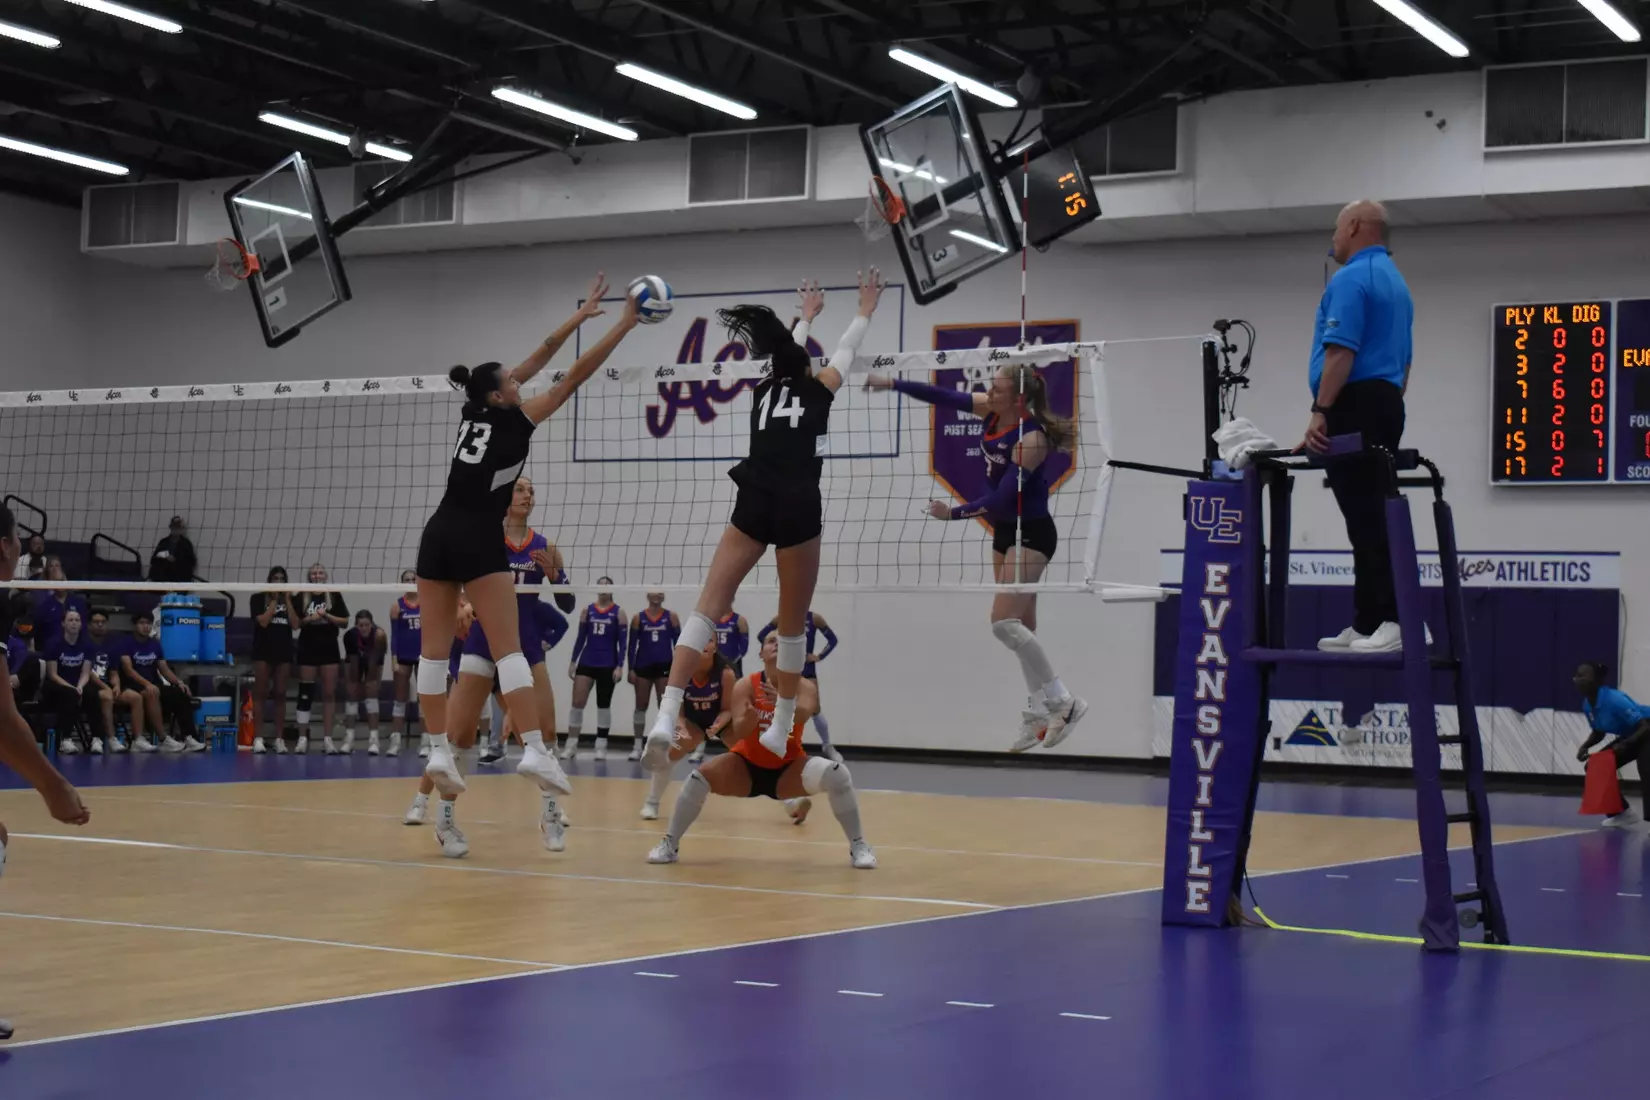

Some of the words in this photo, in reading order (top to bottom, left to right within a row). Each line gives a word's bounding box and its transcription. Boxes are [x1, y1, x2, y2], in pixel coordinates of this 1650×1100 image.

[1505, 307, 1535, 325] PLY
[1543, 306, 1563, 324] KL
[1572, 304, 1600, 323] DIG
[1514, 328, 1529, 350] 2
[1552, 327, 1567, 349] 0
[1591, 326, 1605, 347] 0
[1516, 354, 1529, 375] 3
[1552, 353, 1566, 374] 2
[1591, 352, 1605, 373] 0
[1516, 379, 1528, 399] 7
[1552, 378, 1566, 399] 6
[1590, 377, 1605, 398] 0
[758, 385, 806, 431] 14
[1506, 407, 1528, 425] 11
[1552, 404, 1565, 425] 2
[1590, 403, 1604, 424] 0
[453, 419, 493, 465] 13
[1506, 430, 1527, 452] 15
[1551, 430, 1565, 451] 0
[1592, 429, 1604, 448] 7
[1505, 455, 1527, 475] 17
[1551, 455, 1565, 476] 2
[1597, 457, 1604, 474] 1
[1190, 496, 1242, 544] UE
[1289, 561, 1308, 575] St.
[1456, 557, 1495, 581] Aces
[1496, 560, 1591, 582] ATHLETICS
[1185, 562, 1231, 912] EVANSVILLE
